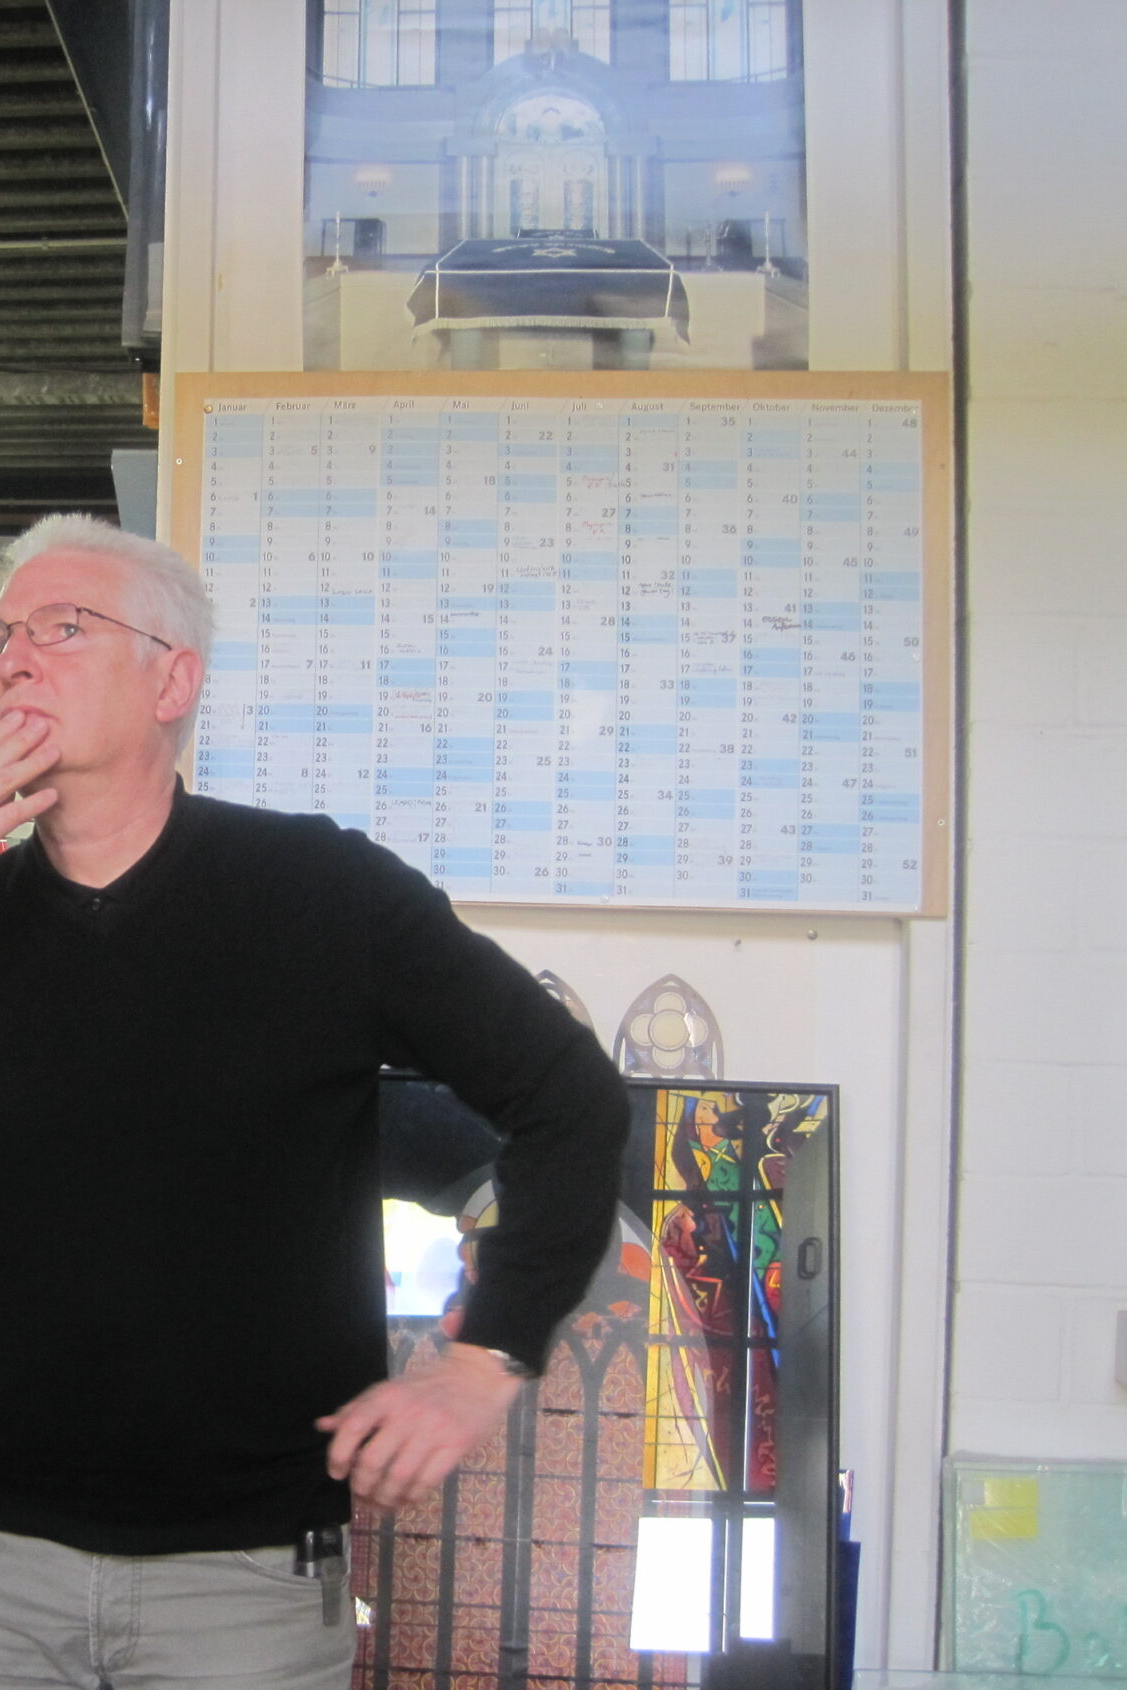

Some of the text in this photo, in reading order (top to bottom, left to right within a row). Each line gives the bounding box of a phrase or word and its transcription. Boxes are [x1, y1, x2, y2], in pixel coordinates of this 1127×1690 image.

[218, 401, 247, 412] Januar
[277, 401, 310, 411] Februar
[334, 400, 356, 410] März
[394, 399, 415, 410] April
[453, 401, 469, 409] Mai
[512, 401, 529, 411] Juni
[572, 401, 586, 412] Juli
[632, 402, 663, 411] August
[690, 402, 740, 412] September
[753, 403, 790, 412] Oktober
[812, 403, 859, 412] November
[872, 404, 919, 413] Dezembr
[721, 416, 736, 426] 35
[902, 418, 917, 428] 48
[270, 431, 275, 441] 2
[327, 430, 333, 440] 2
[539, 431, 553, 440] 22
[567, 431, 572, 441] 2
[685, 432, 691, 441] 2
[311, 445, 318, 455] 5
[369, 445, 376, 454] 9
[446, 445, 452, 454] 3
[842, 449, 857, 458] 44
[211, 461, 217, 471] 4
[386, 460, 392, 469] 4
[505, 461, 510, 470] 4
[625, 463, 631, 472] 4
[662, 462, 675, 472] 31
[807, 464, 812, 473] 4
[866, 465, 872, 474] 4
[484, 476, 496, 485] 18
[747, 478, 753, 488] 5
[210, 492, 216, 501] 6
[253, 492, 257, 501] 1
[445, 491, 451, 501] 6
[566, 492, 572, 502] 6
[685, 493, 691, 503] 6
[782, 494, 798, 504] 40
[425, 506, 436, 515] 14
[602, 508, 616, 517] 27
[325, 521, 331, 531] 8
[386, 521, 392, 530] 8
[504, 522, 510, 532] 8
[722, 524, 737, 534] 36
[747, 524, 753, 534] 8
[904, 527, 919, 537] 49
[267, 537, 273, 546] 9
[539, 538, 554, 547] 23
[625, 539, 631, 549] 9
[807, 541, 813, 550] 9
[867, 542, 873, 552] 9
[205, 552, 215, 562] 10
[308, 552, 316, 561] 6
[321, 552, 331, 561] 10
[363, 552, 374, 561] 10
[500, 553, 510, 562] 10
[843, 557, 858, 567] 45
[864, 558, 874, 568] 10
[661, 570, 675, 580] 32
[263, 582, 271, 592] 12
[441, 584, 450, 593] 12
[482, 584, 494, 593] 19
[744, 587, 753, 597] 12
[804, 588, 813, 598] 12
[250, 598, 256, 608] 2
[381, 598, 390, 608] 13
[562, 600, 571, 610] 13
[621, 601, 631, 611] 13
[681, 601, 690, 611] 13
[784, 603, 796, 613] 41
[262, 613, 270, 623] 14
[381, 613, 390, 623] 14
[423, 614, 434, 624] 15
[440, 614, 449, 624] 14
[500, 615, 508, 624] 14
[561, 616, 570, 625] 14
[601, 616, 615, 626] 28
[320, 629, 329, 638] 15
[721, 633, 736, 644] 37
[904, 637, 919, 647] 50
[538, 646, 553, 656] 24
[621, 648, 630, 658] 16
[681, 649, 690, 658] 16
[803, 651, 813, 661] 16
[840, 652, 856, 662] 46
[864, 652, 873, 662] 16
[306, 659, 313, 669] 7
[361, 660, 370, 669] 11
[743, 665, 753, 675] 17
[319, 675, 328, 685] 18
[439, 676, 448, 686] 18
[660, 680, 674, 689] 33
[477, 692, 493, 702] 20
[620, 695, 630, 705] 19
[743, 697, 752, 706] 19
[803, 698, 813, 708] 19
[247, 705, 253, 715] 3
[377, 707, 389, 717] 20
[559, 709, 570, 719] 20
[782, 713, 797, 724] 42
[200, 720, 210, 730] 21
[259, 721, 268, 731] 21
[421, 723, 432, 733] 16
[496, 724, 506, 734] 21
[599, 726, 614, 736] 29
[679, 727, 688, 737] 21
[862, 731, 872, 741] 21
[316, 737, 327, 747] 22
[679, 743, 690, 753] 22
[719, 744, 734, 754] 38
[905, 748, 917, 758] 51
[377, 754, 388, 764] 23
[537, 756, 551, 766] 25
[257, 767, 267, 777] 24
[301, 768, 308, 777] 8
[358, 769, 369, 779] 12
[496, 771, 507, 781] 24
[558, 772, 569, 782] 24
[618, 773, 629, 784] 24
[802, 777, 813, 787] 24
[842, 778, 857, 788] 47
[862, 778, 873, 789] 24
[198, 781, 209, 791] 25
[435, 786, 447, 796] 25
[657, 790, 673, 800] 34
[740, 792, 752, 802] 25
[314, 799, 325, 809] 26
[435, 801, 447, 812] 26
[475, 802, 486, 812] 21
[557, 804, 569, 814] 26
[740, 808, 752, 818] 26
[801, 809, 813, 819] 26
[780, 825, 796, 835] 43
[375, 833, 386, 841] 28
[418, 833, 430, 842] 17
[597, 836, 612, 846] 30
[617, 837, 628, 847] 28
[677, 838, 689, 848] 28
[861, 842, 873, 853] 28
[494, 850, 506, 860] 29
[718, 855, 733, 865] 39
[434, 864, 446, 874] 30
[903, 860, 917, 870] 52
[493, 866, 505, 876] 30
[534, 867, 549, 877] 26
[555, 867, 568, 877] 30
[616, 869, 628, 879] 30
[677, 870, 689, 880] 30
[739, 871, 752, 882] 30
[800, 873, 812, 883] 30
[861, 874, 873, 885] 30
